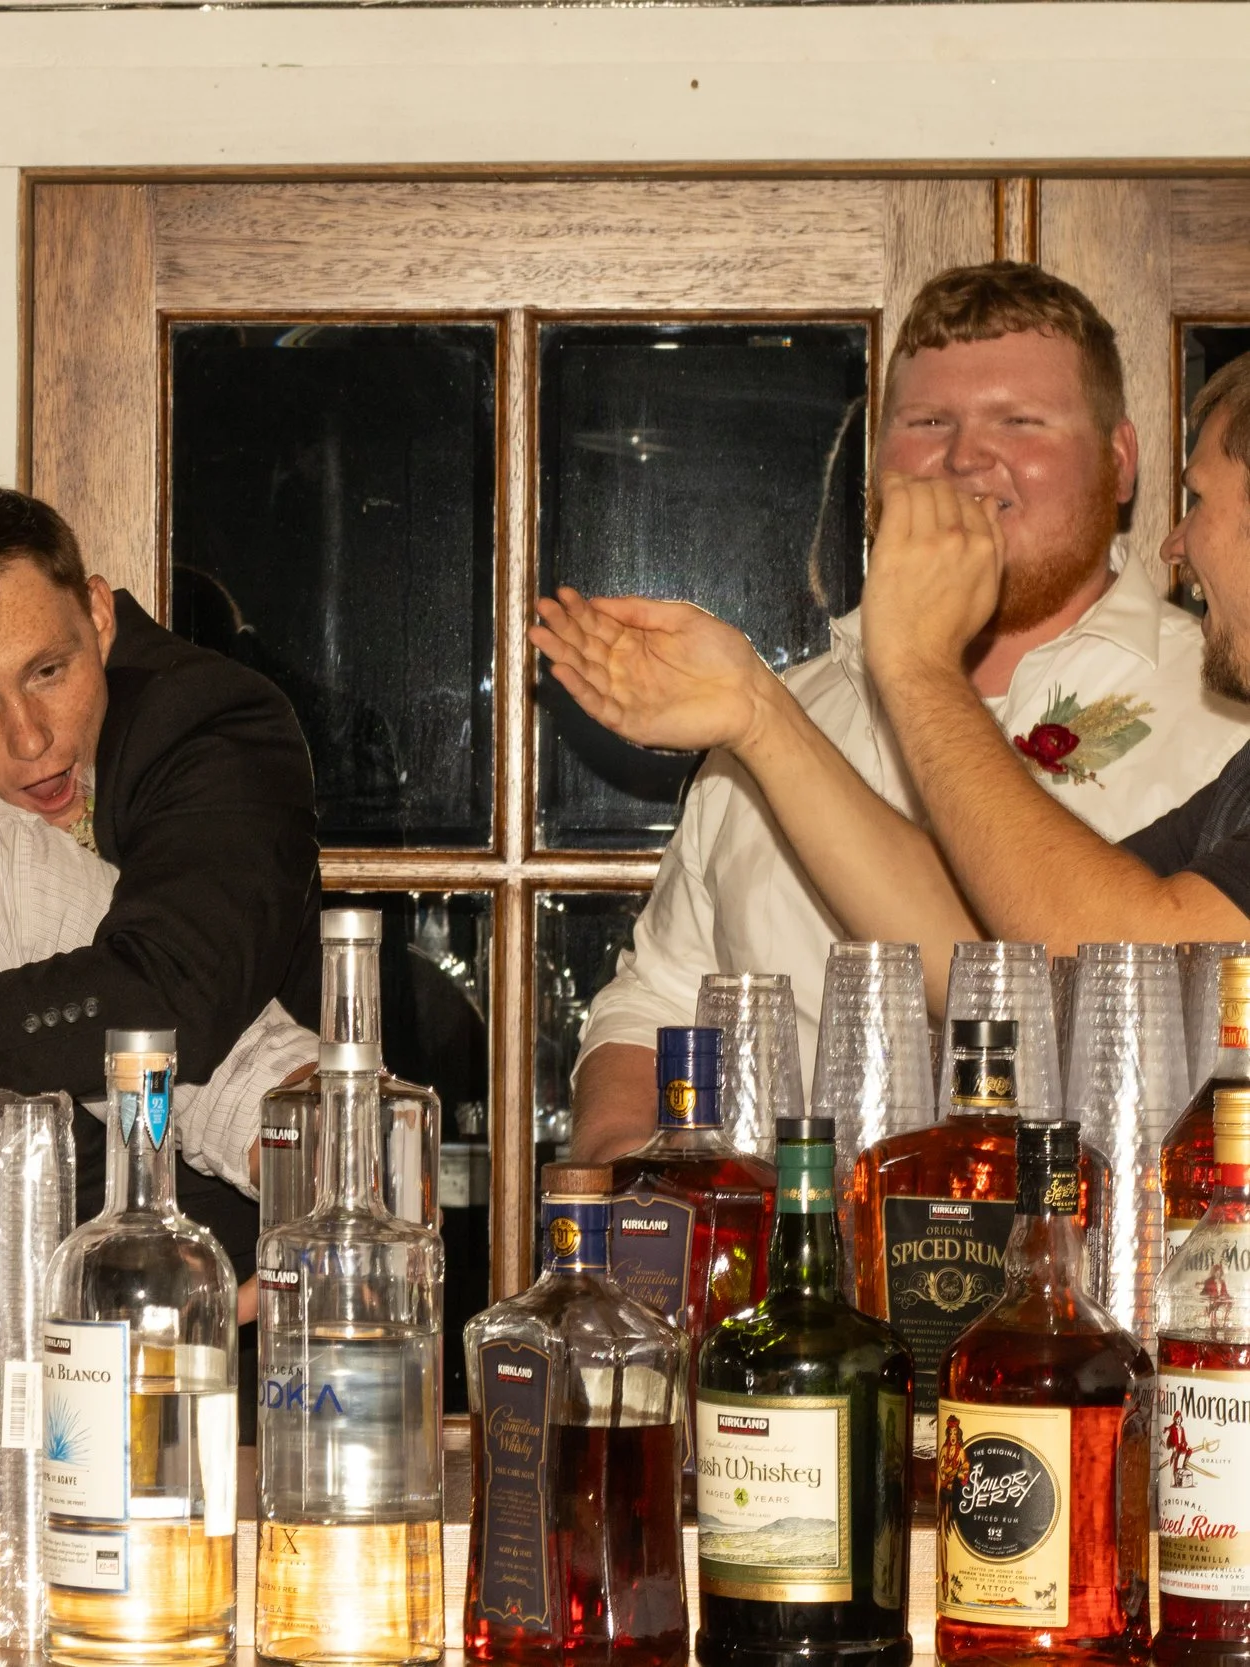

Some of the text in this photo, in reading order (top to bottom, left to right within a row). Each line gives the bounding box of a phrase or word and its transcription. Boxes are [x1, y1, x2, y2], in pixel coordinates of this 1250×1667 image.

[152, 1097, 164, 1109] 92
[932, 1206, 969, 1215] KIRKLAND
[622, 1219, 668, 1231] KIRKLAND
[926, 1226, 974, 1238] ORIGINAL
[891, 1239, 1006, 1269] SPICED RUM
[58, 1363, 111, 1383] BLANCO
[497, 1364, 533, 1379] KIRKLAND
[1177, 1386, 1250, 1427] Morgan
[488, 1404, 541, 1437] Canadian
[719, 1416, 768, 1430] KIRKLAND
[499, 1433, 533, 1462] Whisky
[973, 1448, 1021, 1460] THE ORIGINAL
[697, 1455, 822, 1489] rish Whiskey
[57, 1474, 78, 1486] AGAVE
[961, 1462, 1028, 1499] SAILOR
[710, 1490, 790, 1504] AGED 4 YEARS
[959, 1470, 1042, 1514] JERRY
[1163, 1498, 1203, 1512] ORIGINAL
[973, 1514, 1019, 1524] SPICED RUM
[1187, 1514, 1239, 1542] Rum
[513, 1546, 519, 1557] 6
[1190, 1555, 1231, 1564] VANILLA
[277, 1585, 299, 1594] FREE
[975, 1583, 1015, 1593] TATTOO
